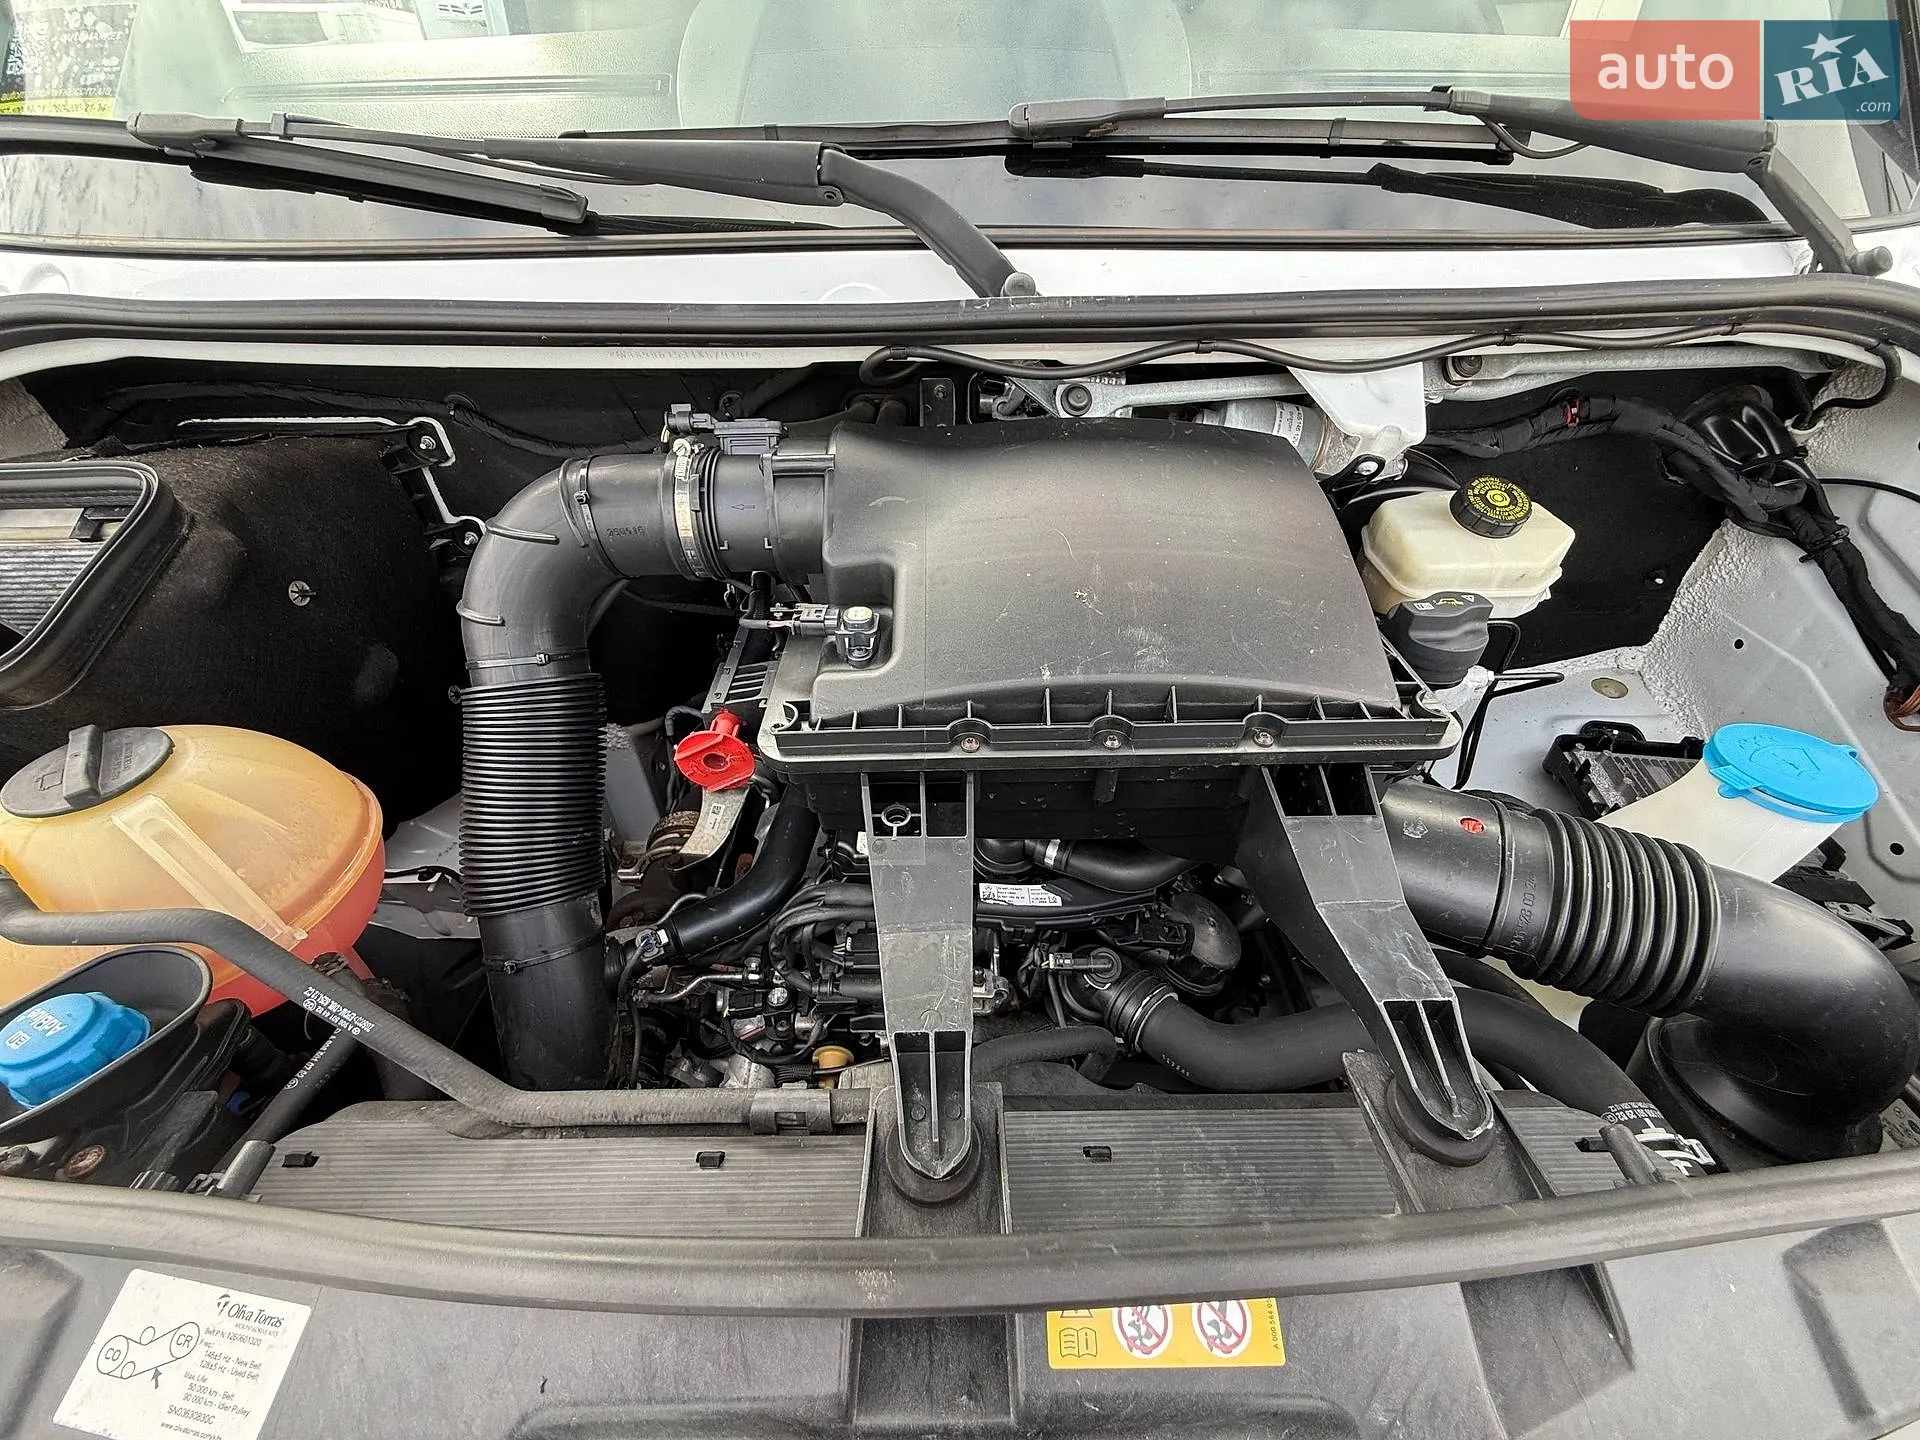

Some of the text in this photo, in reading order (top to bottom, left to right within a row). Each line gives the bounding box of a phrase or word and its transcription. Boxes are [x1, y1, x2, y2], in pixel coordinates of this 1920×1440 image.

[228, 1303, 285, 1328] Oliva Torras
[176, 1333, 193, 1348] CR
[1270, 1326, 1278, 1342] 000
[104, 1347, 121, 1362] CO
